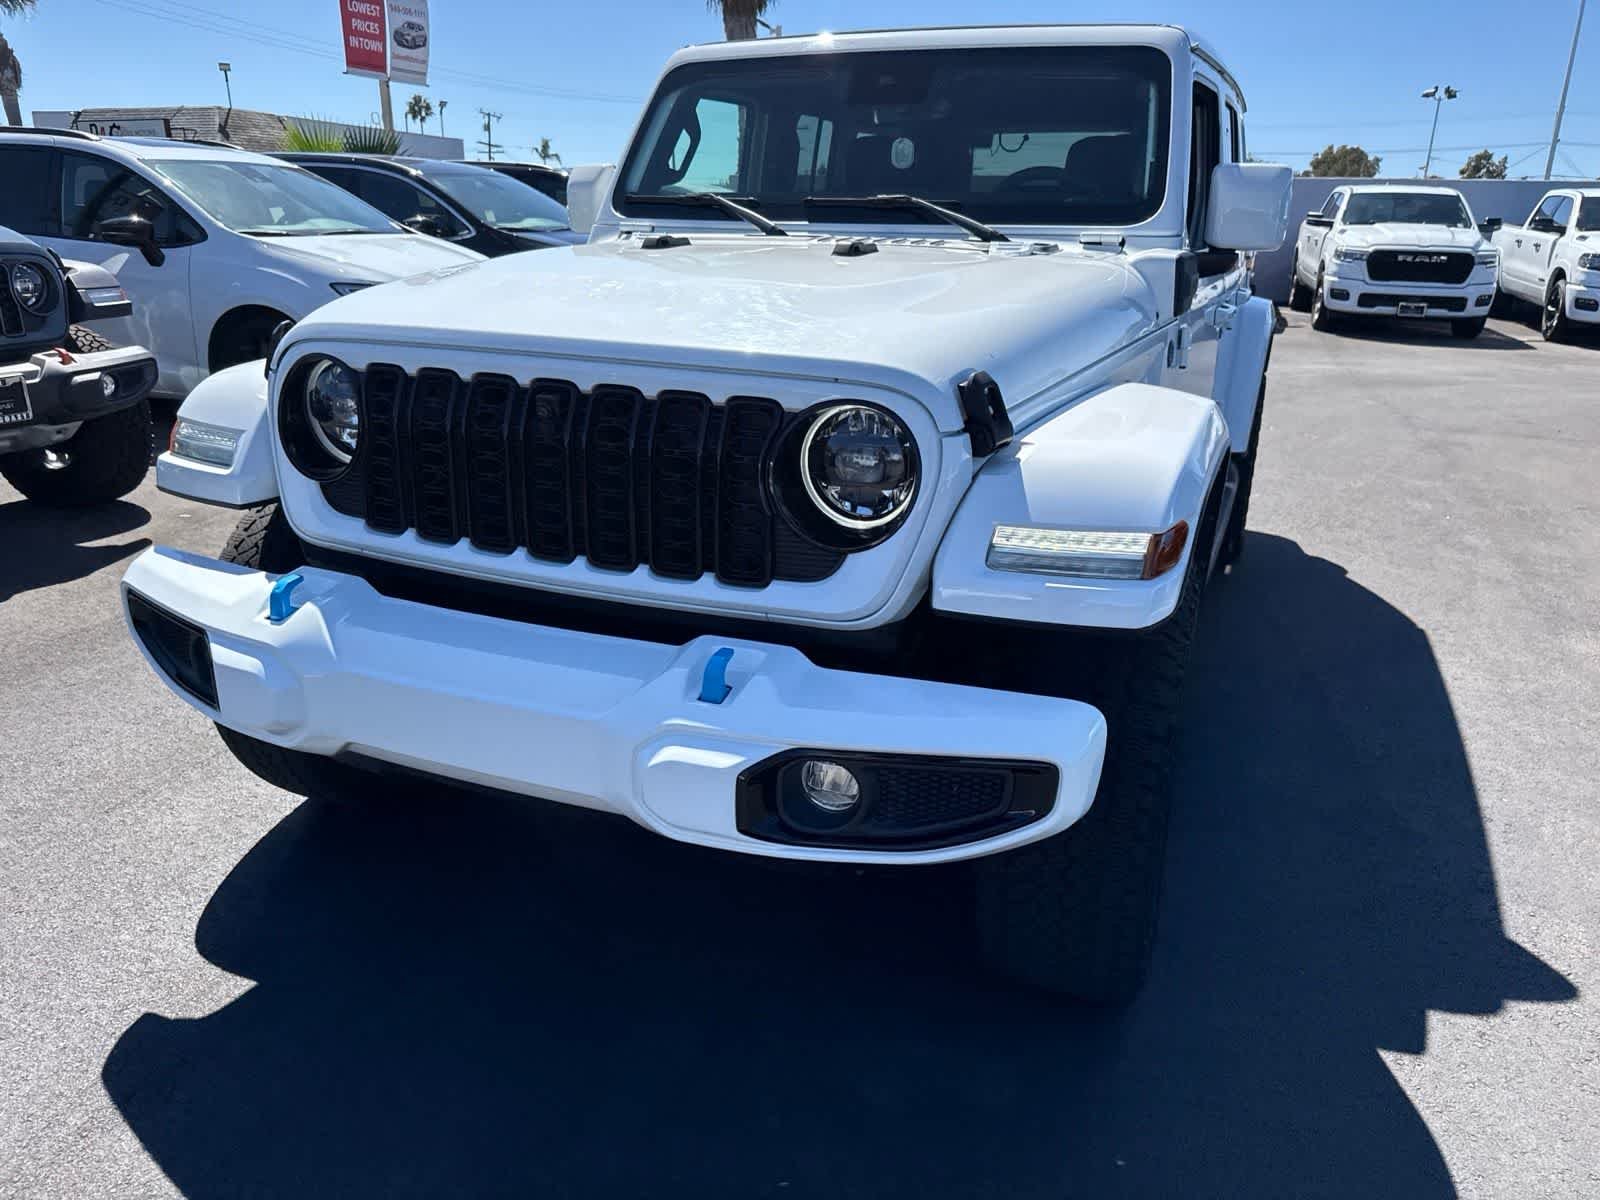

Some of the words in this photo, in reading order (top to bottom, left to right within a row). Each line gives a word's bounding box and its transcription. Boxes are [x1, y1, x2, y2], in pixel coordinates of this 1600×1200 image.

[347, 0, 380, 17] LOWEST
[351, 18, 380, 34] PRICES
[349, 34, 359, 49] IN
[359, 37, 383, 53] TOWN
